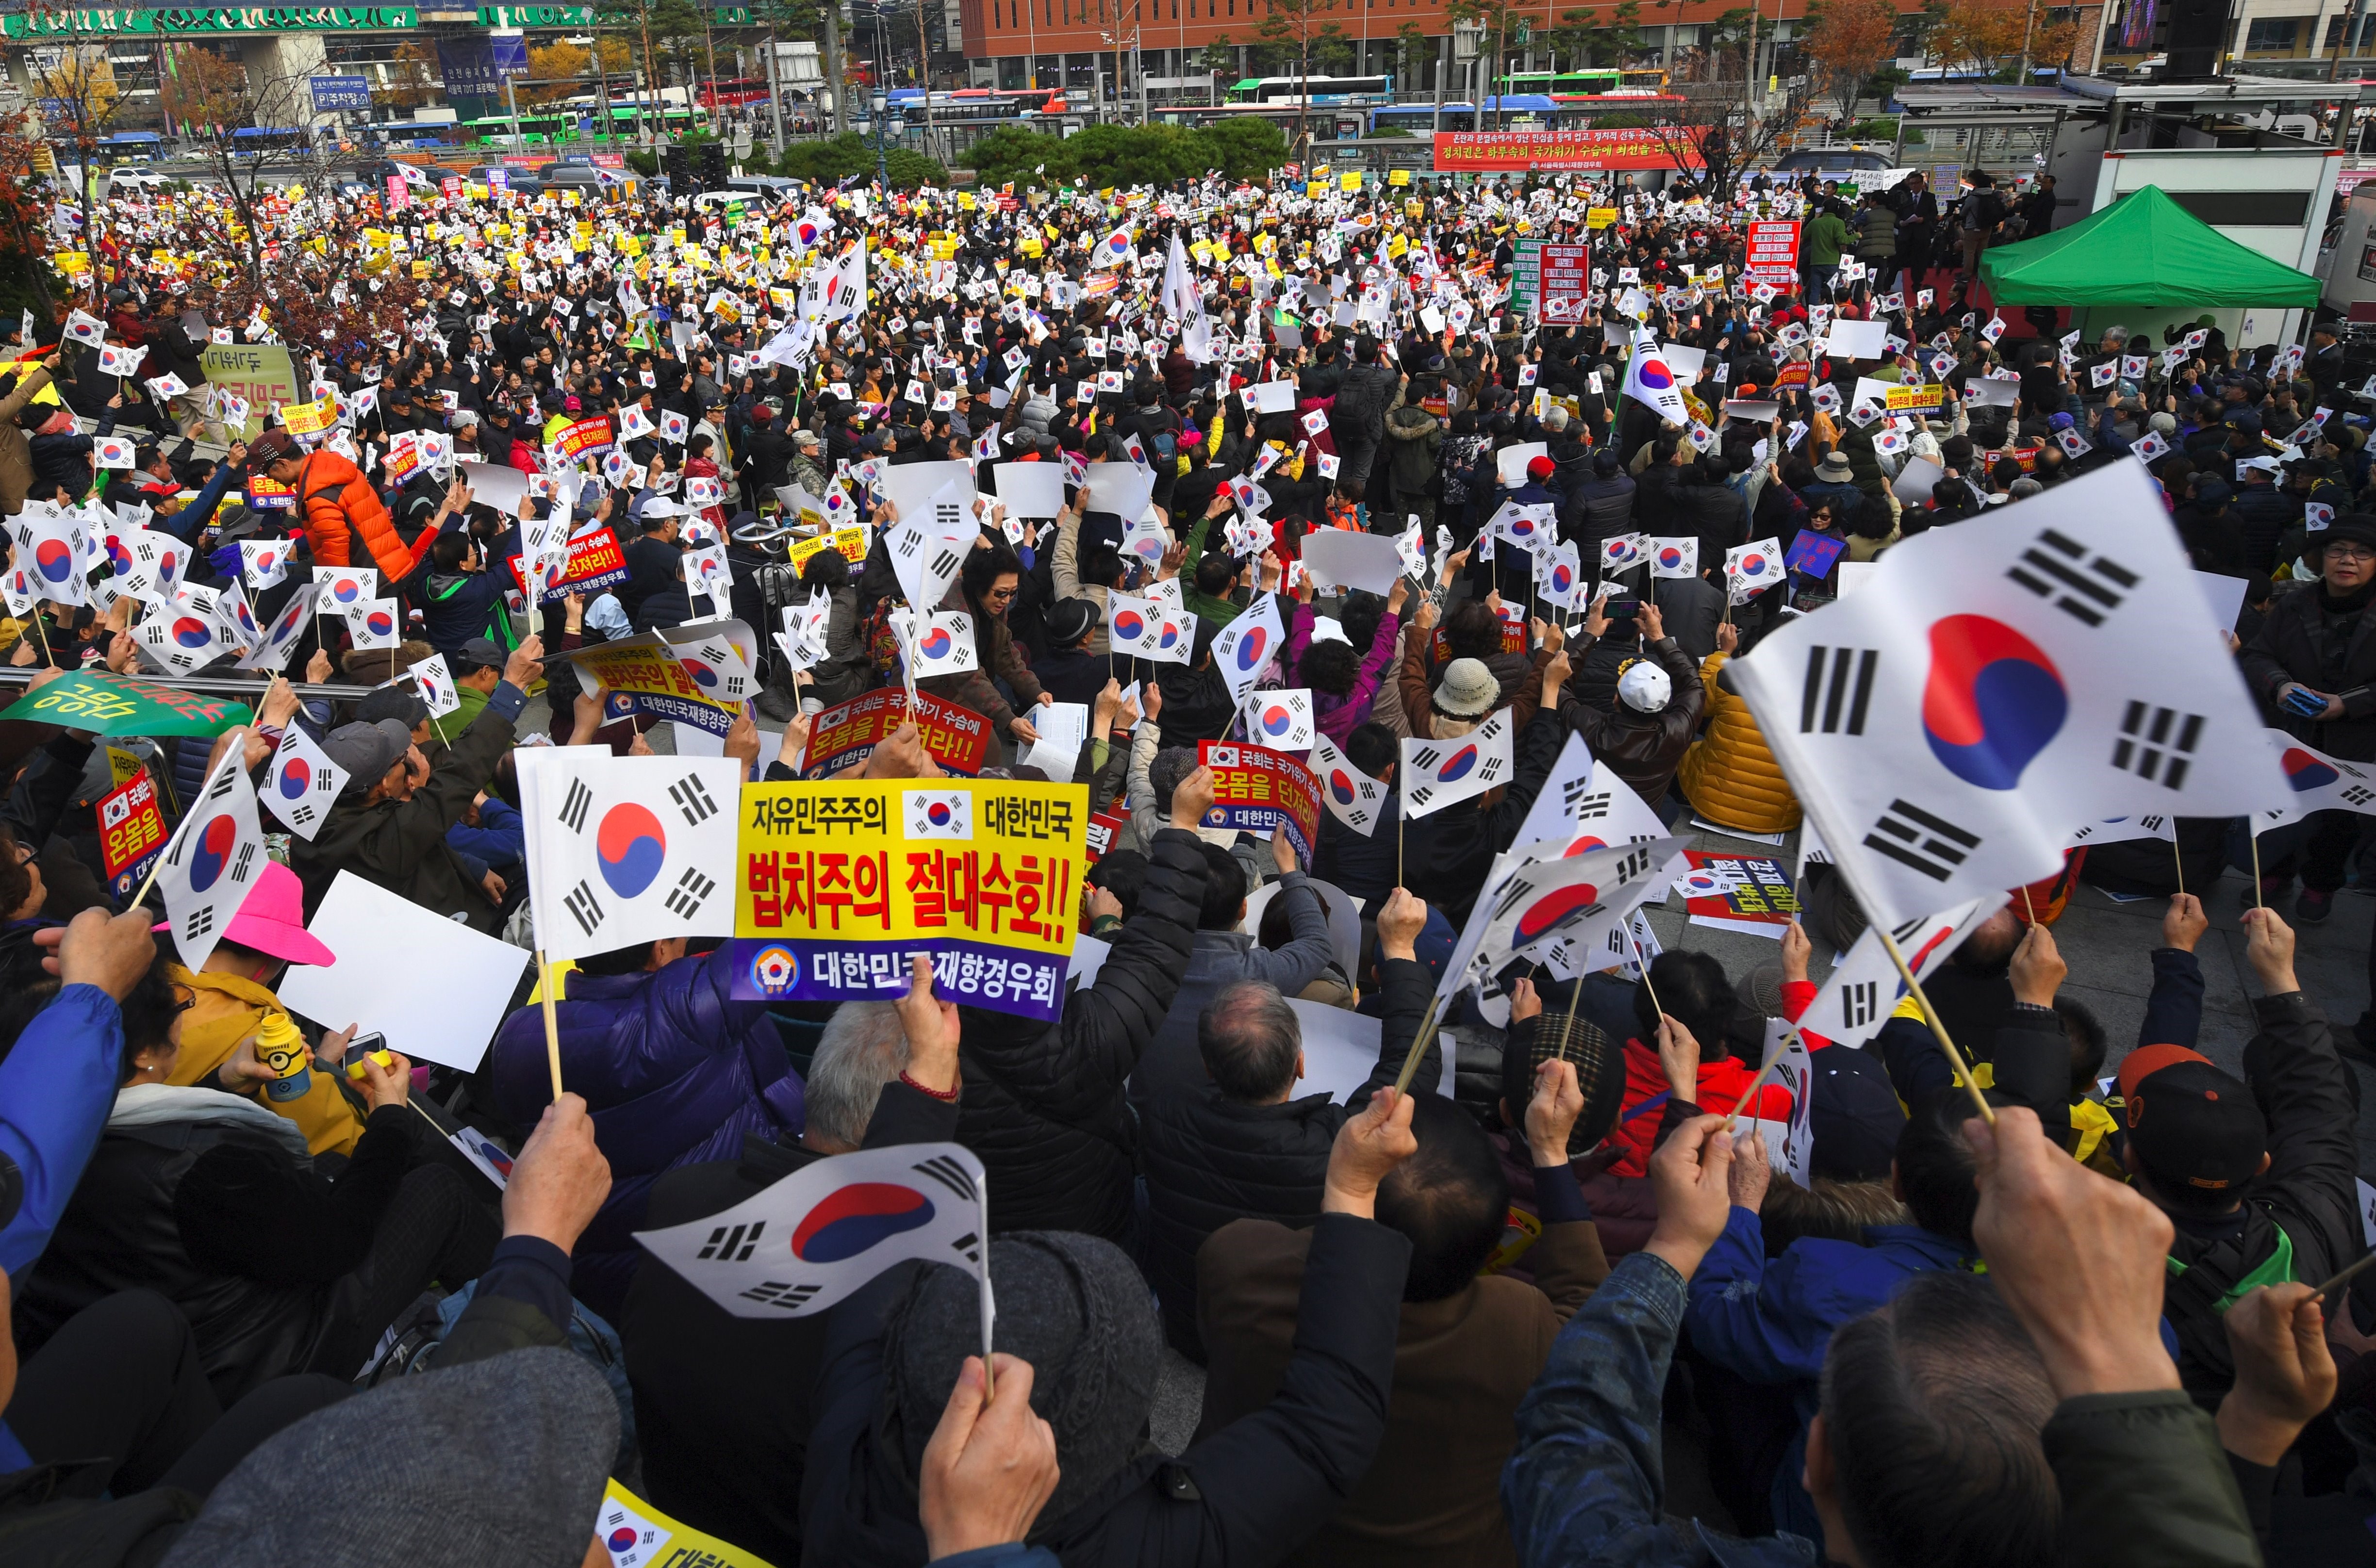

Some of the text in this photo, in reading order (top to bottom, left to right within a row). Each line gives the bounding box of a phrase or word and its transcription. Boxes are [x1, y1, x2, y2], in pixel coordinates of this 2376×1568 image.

[329, 93, 357, 105] 주차장
[448, 83, 497, 95] 서울역 7017 프로젝트
[1453, 134, 1474, 144] 혼란과
[1476, 134, 1512, 144] 분열속에서
[1515, 133, 1529, 144] 성난
[1532, 133, 1553, 143] 민심을
[1557, 133, 1572, 142] 등에
[1574, 132, 1592, 142] 업고,
[1593, 131, 1617, 141] 정치적
[1442, 146, 1484, 160] 정치권은
[1487, 145, 1529, 160] 하루속히
[1533, 145, 1575, 159] 국가위기
[1579, 144, 1613, 157] 수습에
[1616, 142, 1650, 157] 최선을
[1540, 161, 1601, 170] 서울특별시재향경우회
[1783, 372, 1806, 382] 던져라!!
[286, 406, 314, 416] 자유민주주의
[1888, 393, 1940, 408] 법치주의 절대수호!!
[288, 416, 320, 433] 법치주의
[563, 428, 610, 454] 온몸을 던져라!!
[588, 532, 611, 550] 수습에
[792, 530, 860, 557] 자유민주주의 대한민국
[566, 547, 618, 579] 던져라!!
[1503, 624, 1521, 636] 수습에
[593, 663, 670, 692] 법치주의
[851, 695, 885, 716] 국회는
[942, 709, 981, 736] 수습에
[811, 716, 874, 761] 온몸을
[1241, 750, 1321, 809] 국회는 국가위기 수습에
[129, 779, 151, 807] 국회는
[1213, 770, 1317, 838] 온몸을 던져라!!
[752, 795, 1073, 842] 자유민주주의 대한민국
[109, 807, 160, 867] 온몸을
[748, 849, 1071, 943] 법치주의 절대수호!!
[1746, 860, 1803, 912] 강제 하야
